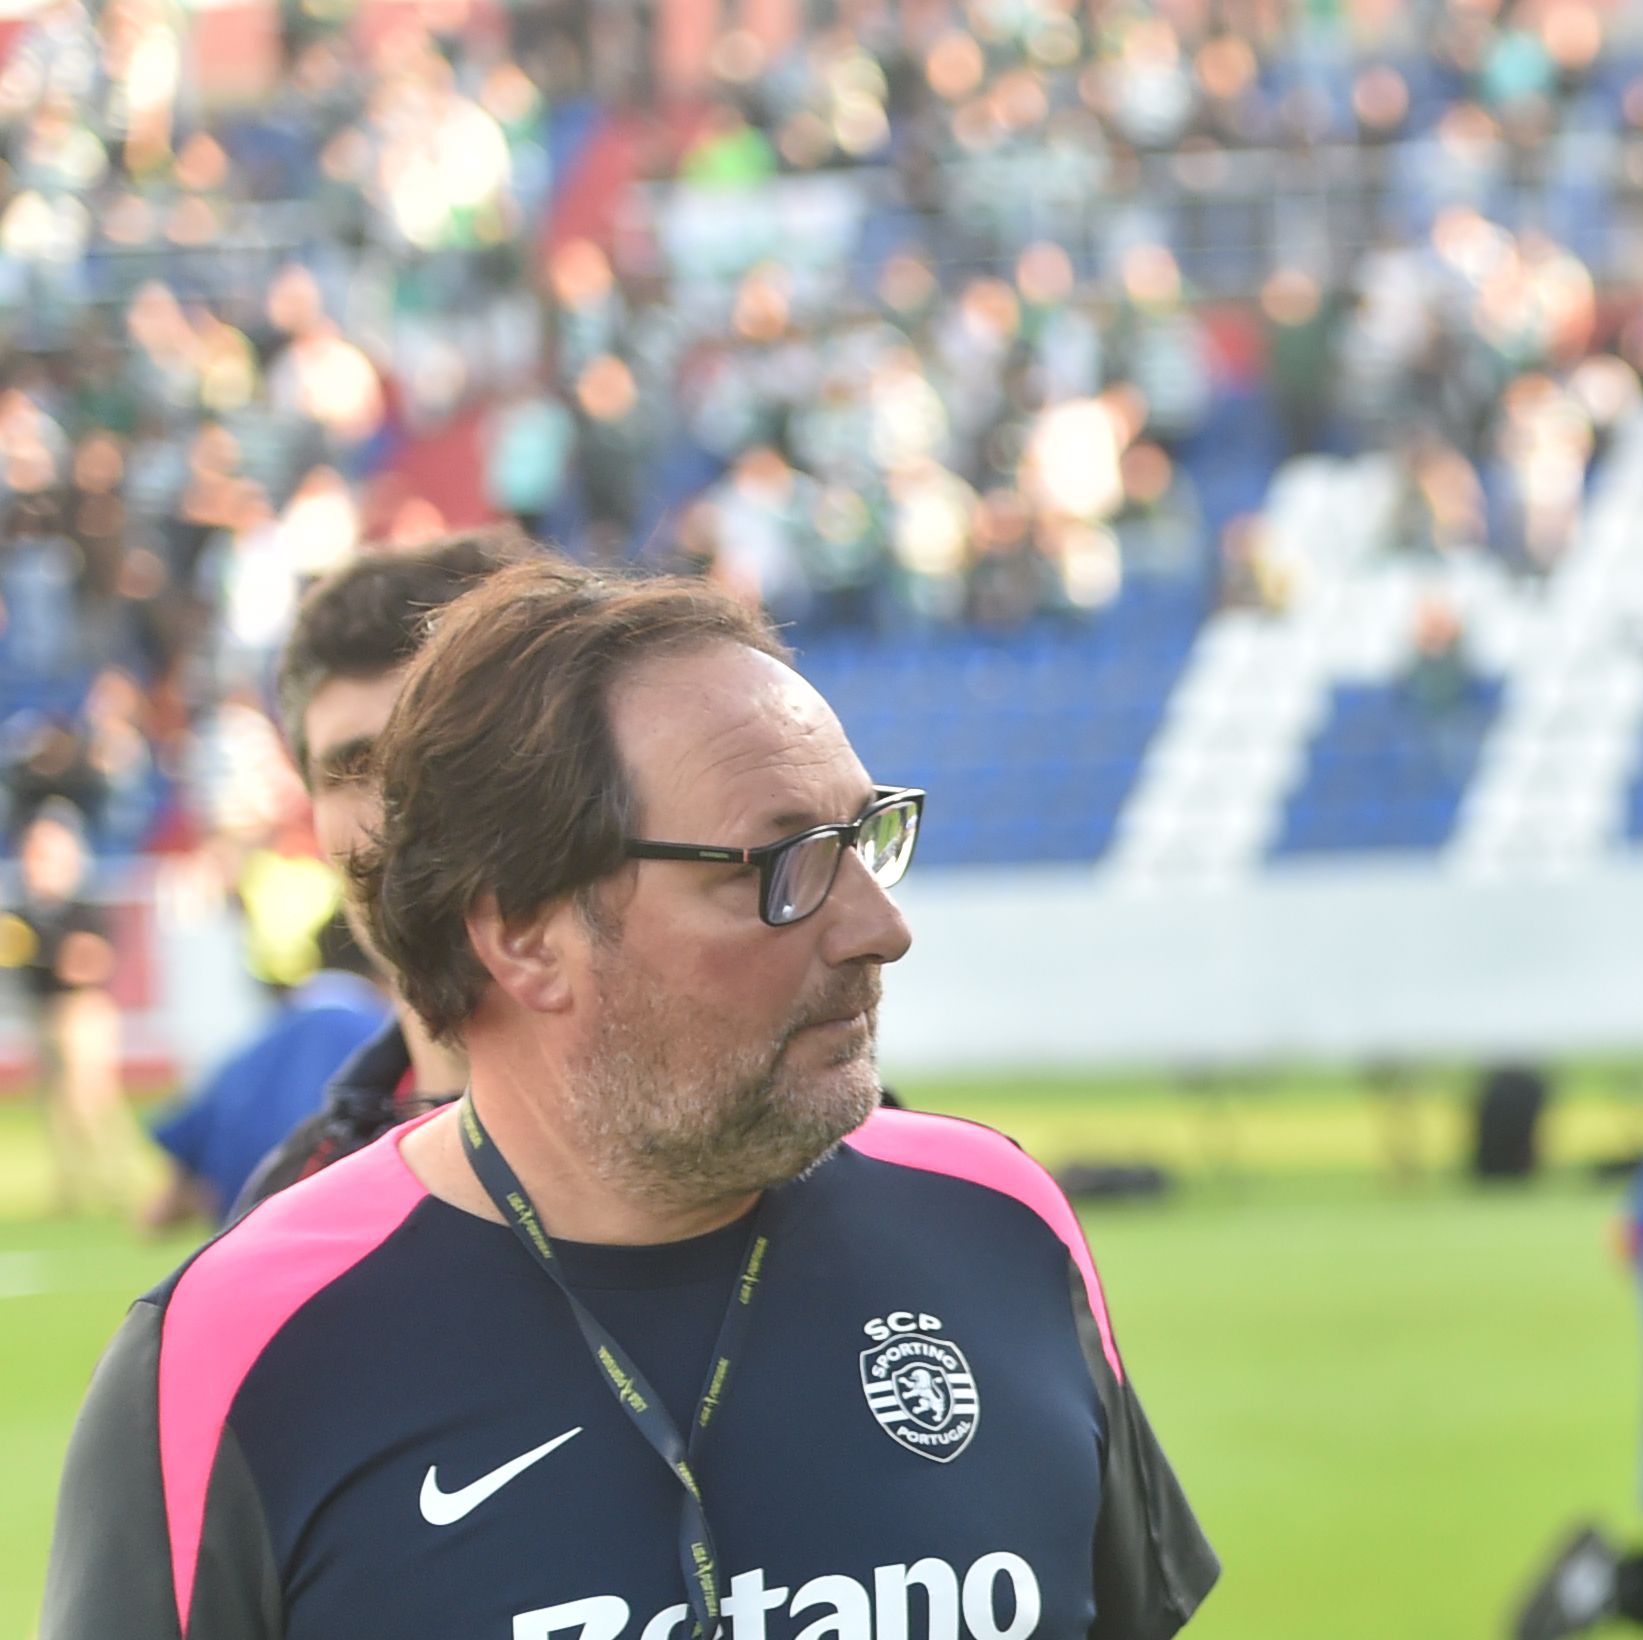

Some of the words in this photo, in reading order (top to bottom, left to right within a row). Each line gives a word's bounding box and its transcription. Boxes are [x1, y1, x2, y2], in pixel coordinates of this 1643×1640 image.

[864, 1311, 942, 1341] SCP
[872, 1342, 959, 1379] SPORTING
[897, 1420, 972, 1446] PORTUGAL
